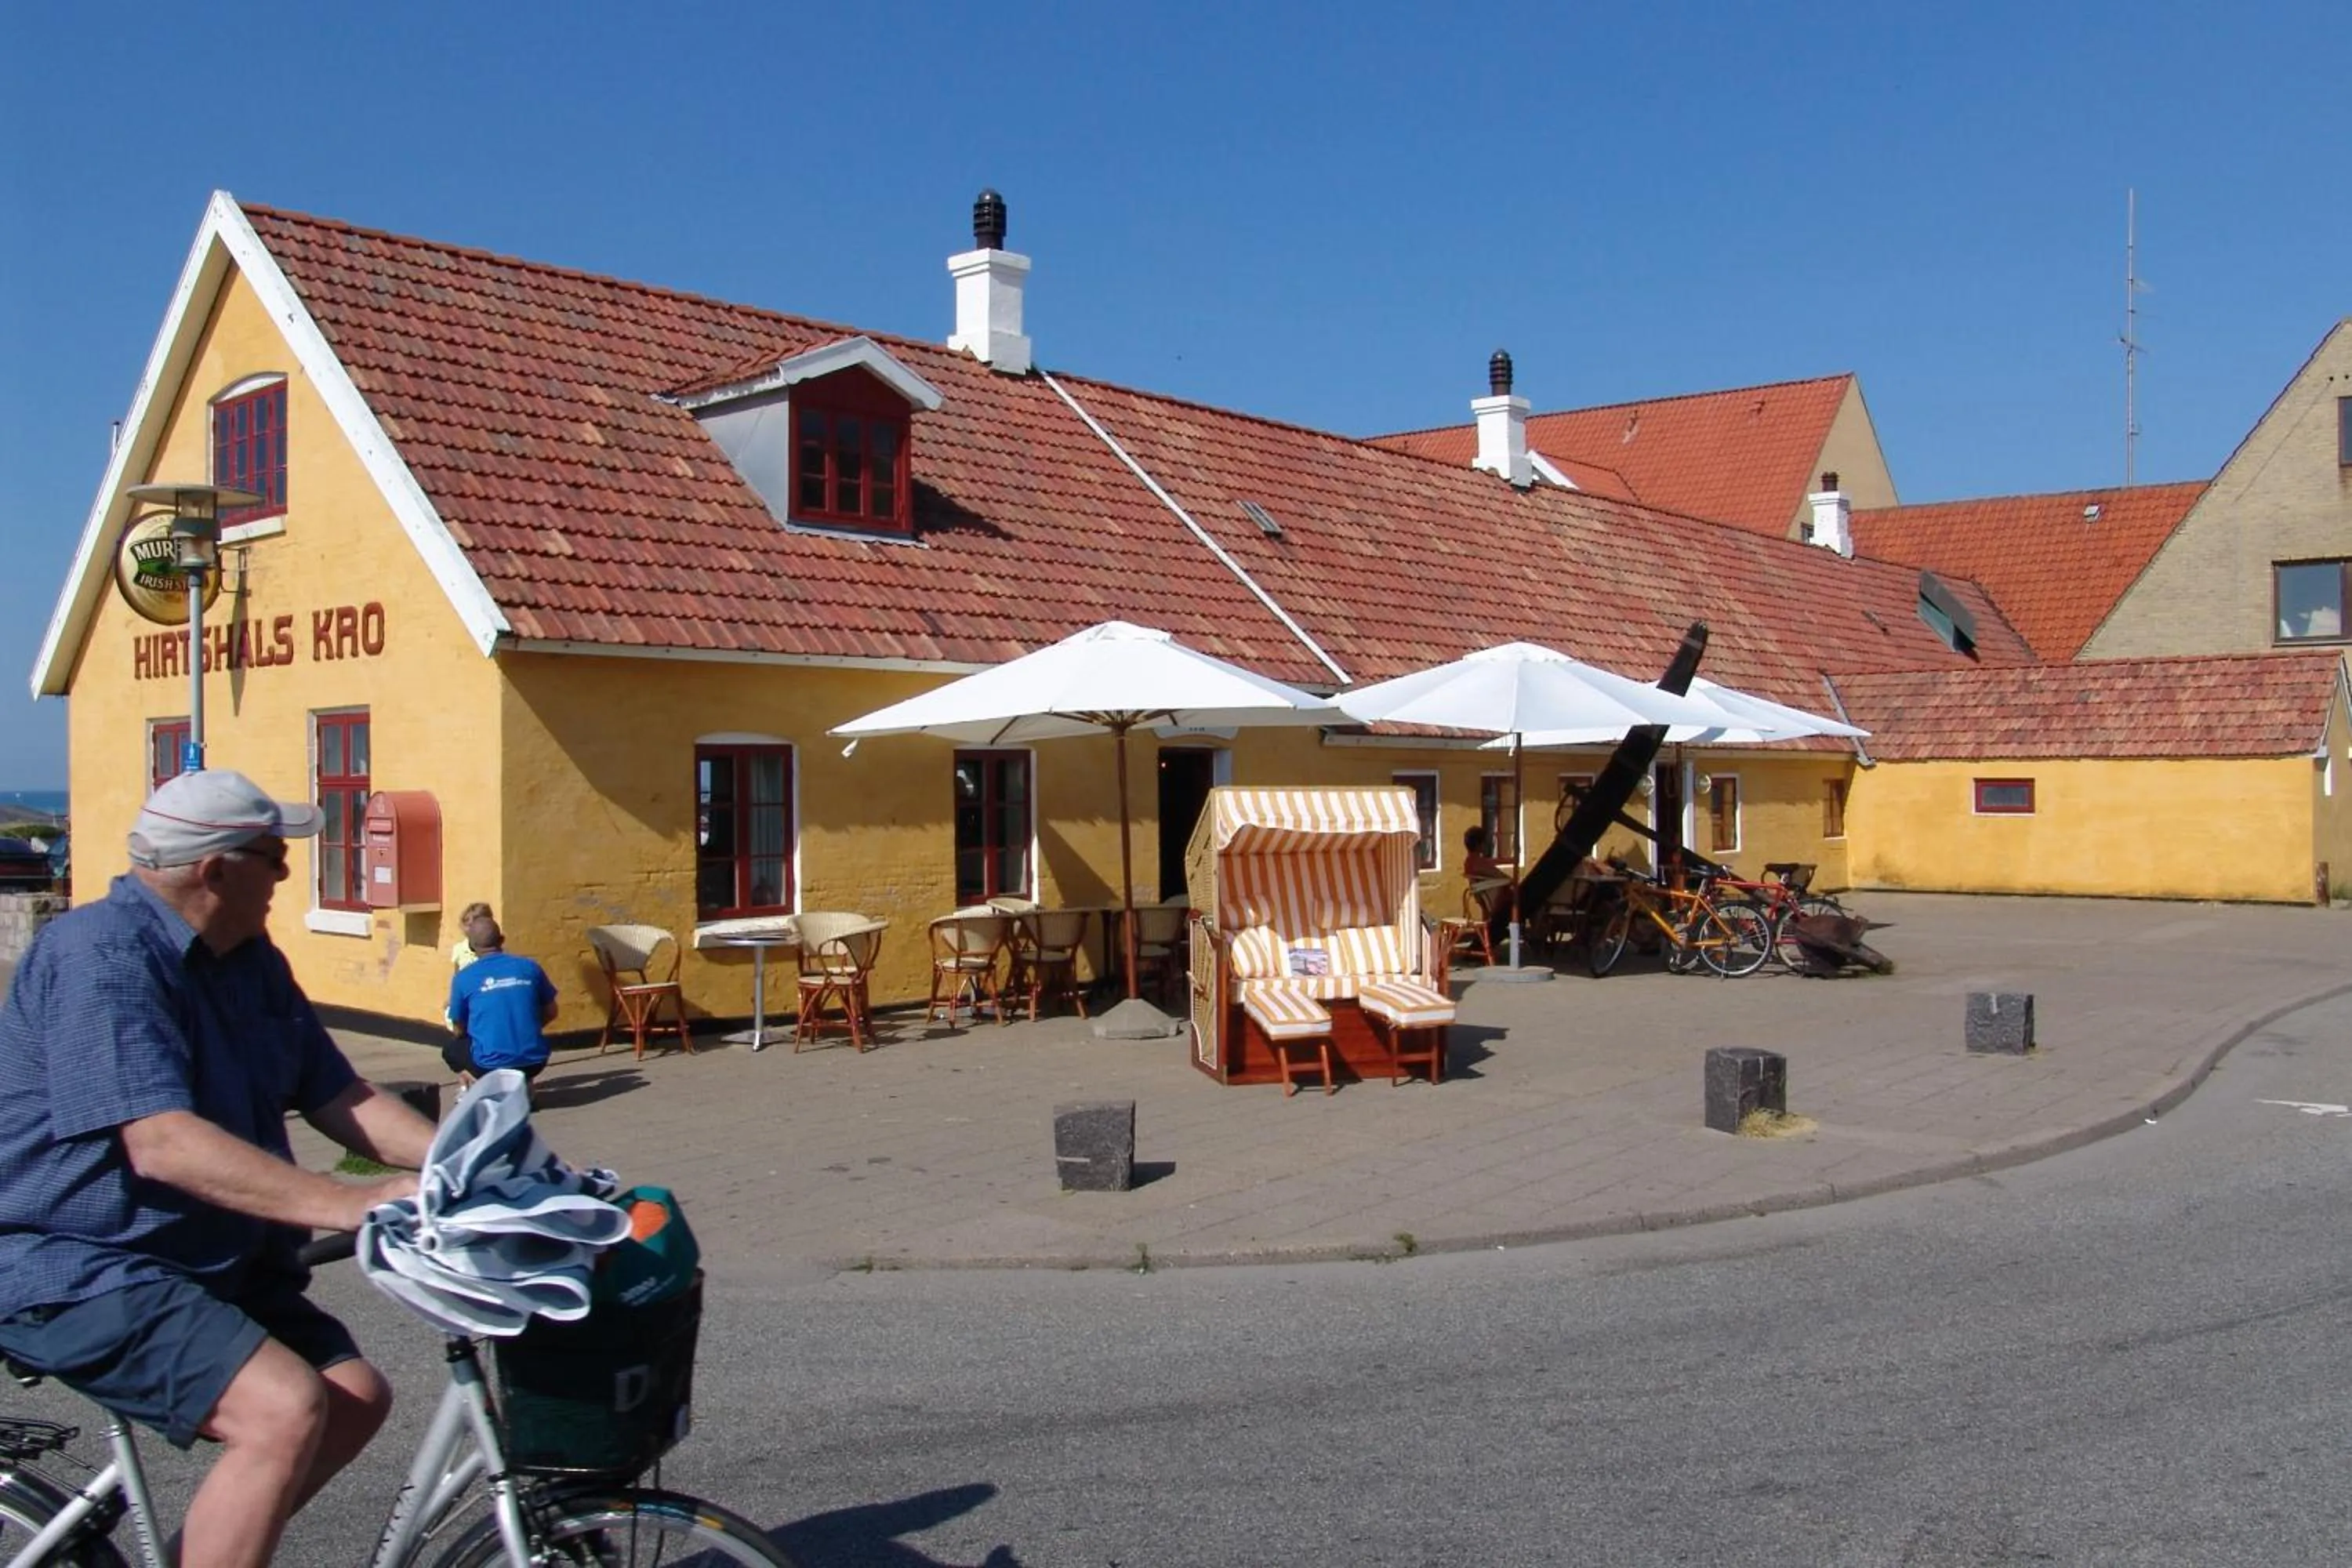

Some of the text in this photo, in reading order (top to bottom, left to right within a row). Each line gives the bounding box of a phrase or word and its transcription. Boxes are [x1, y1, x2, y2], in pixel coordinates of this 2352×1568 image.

[140, 573, 173, 590] IRISH
[134, 601, 385, 681] HIRTSHALS KRO
